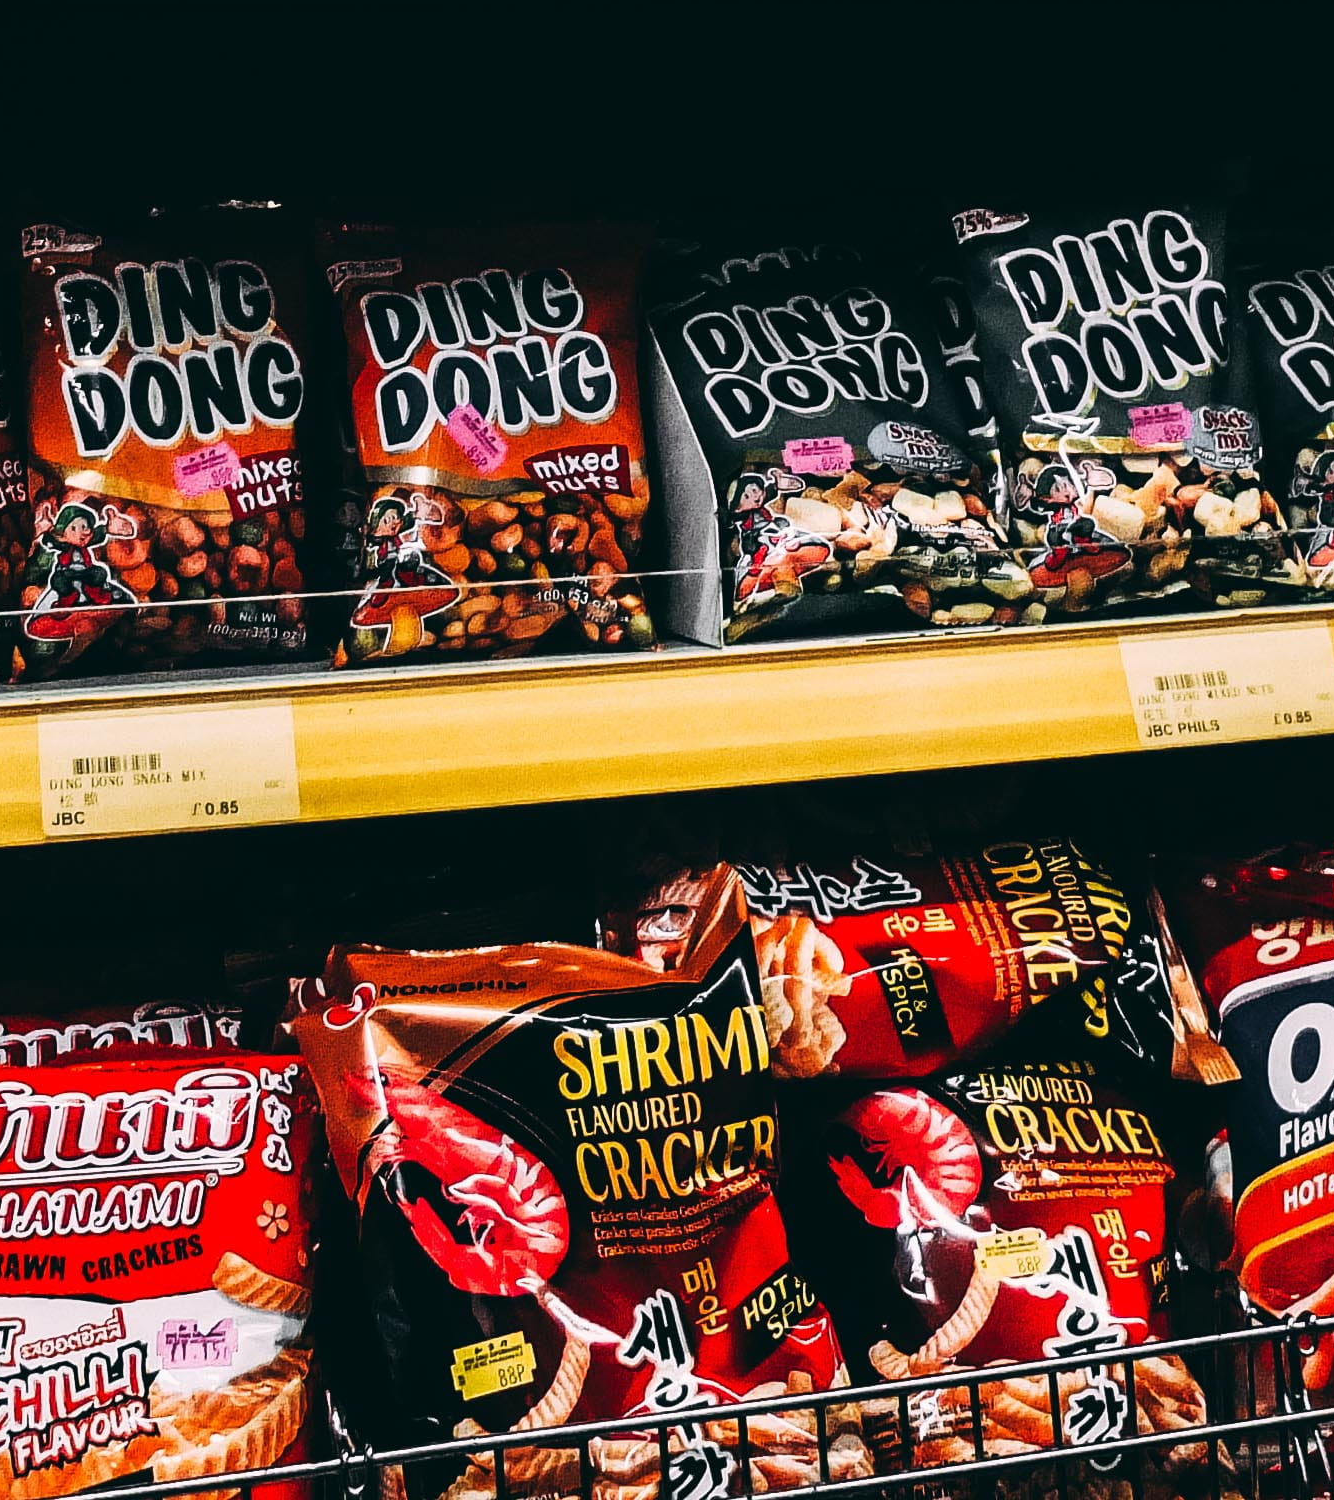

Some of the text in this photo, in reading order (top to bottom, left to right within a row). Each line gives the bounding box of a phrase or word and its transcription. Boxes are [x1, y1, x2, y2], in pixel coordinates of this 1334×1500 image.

[998, 209, 1209, 335] DING
[54, 254, 276, 366] DING
[359, 267, 584, 370] DING
[682, 287, 892, 376] DING
[60, 337, 304, 459] DONG
[375, 331, 618, 453] DONG
[703, 331, 930, 440] DONG
[531, 444, 621, 483] mixed
[1215, 427, 1251, 452] mix
[544, 472, 619, 494] nuts
[1145, 710, 1313, 739] JBC PHILS 0.85
[51, 800, 239, 827] JBC 0.85
[379, 980, 528, 999] NONGSHIM
[881, 967, 920, 1039] SPICY
[891, 947, 930, 996] HOT
[565, 1091, 703, 1139] FLAVOURED
[574, 1114, 778, 1204] CRACKER
[81, 1234, 205, 1284] CRACKERS
[1090, 1207, 1140, 1281] 매운
[679, 1256, 730, 1337] 매운
[742, 1274, 789, 1331] HOT
[497, 1361, 527, 1388] 88P
[12, 1399, 161, 1476] FLAVOUR
